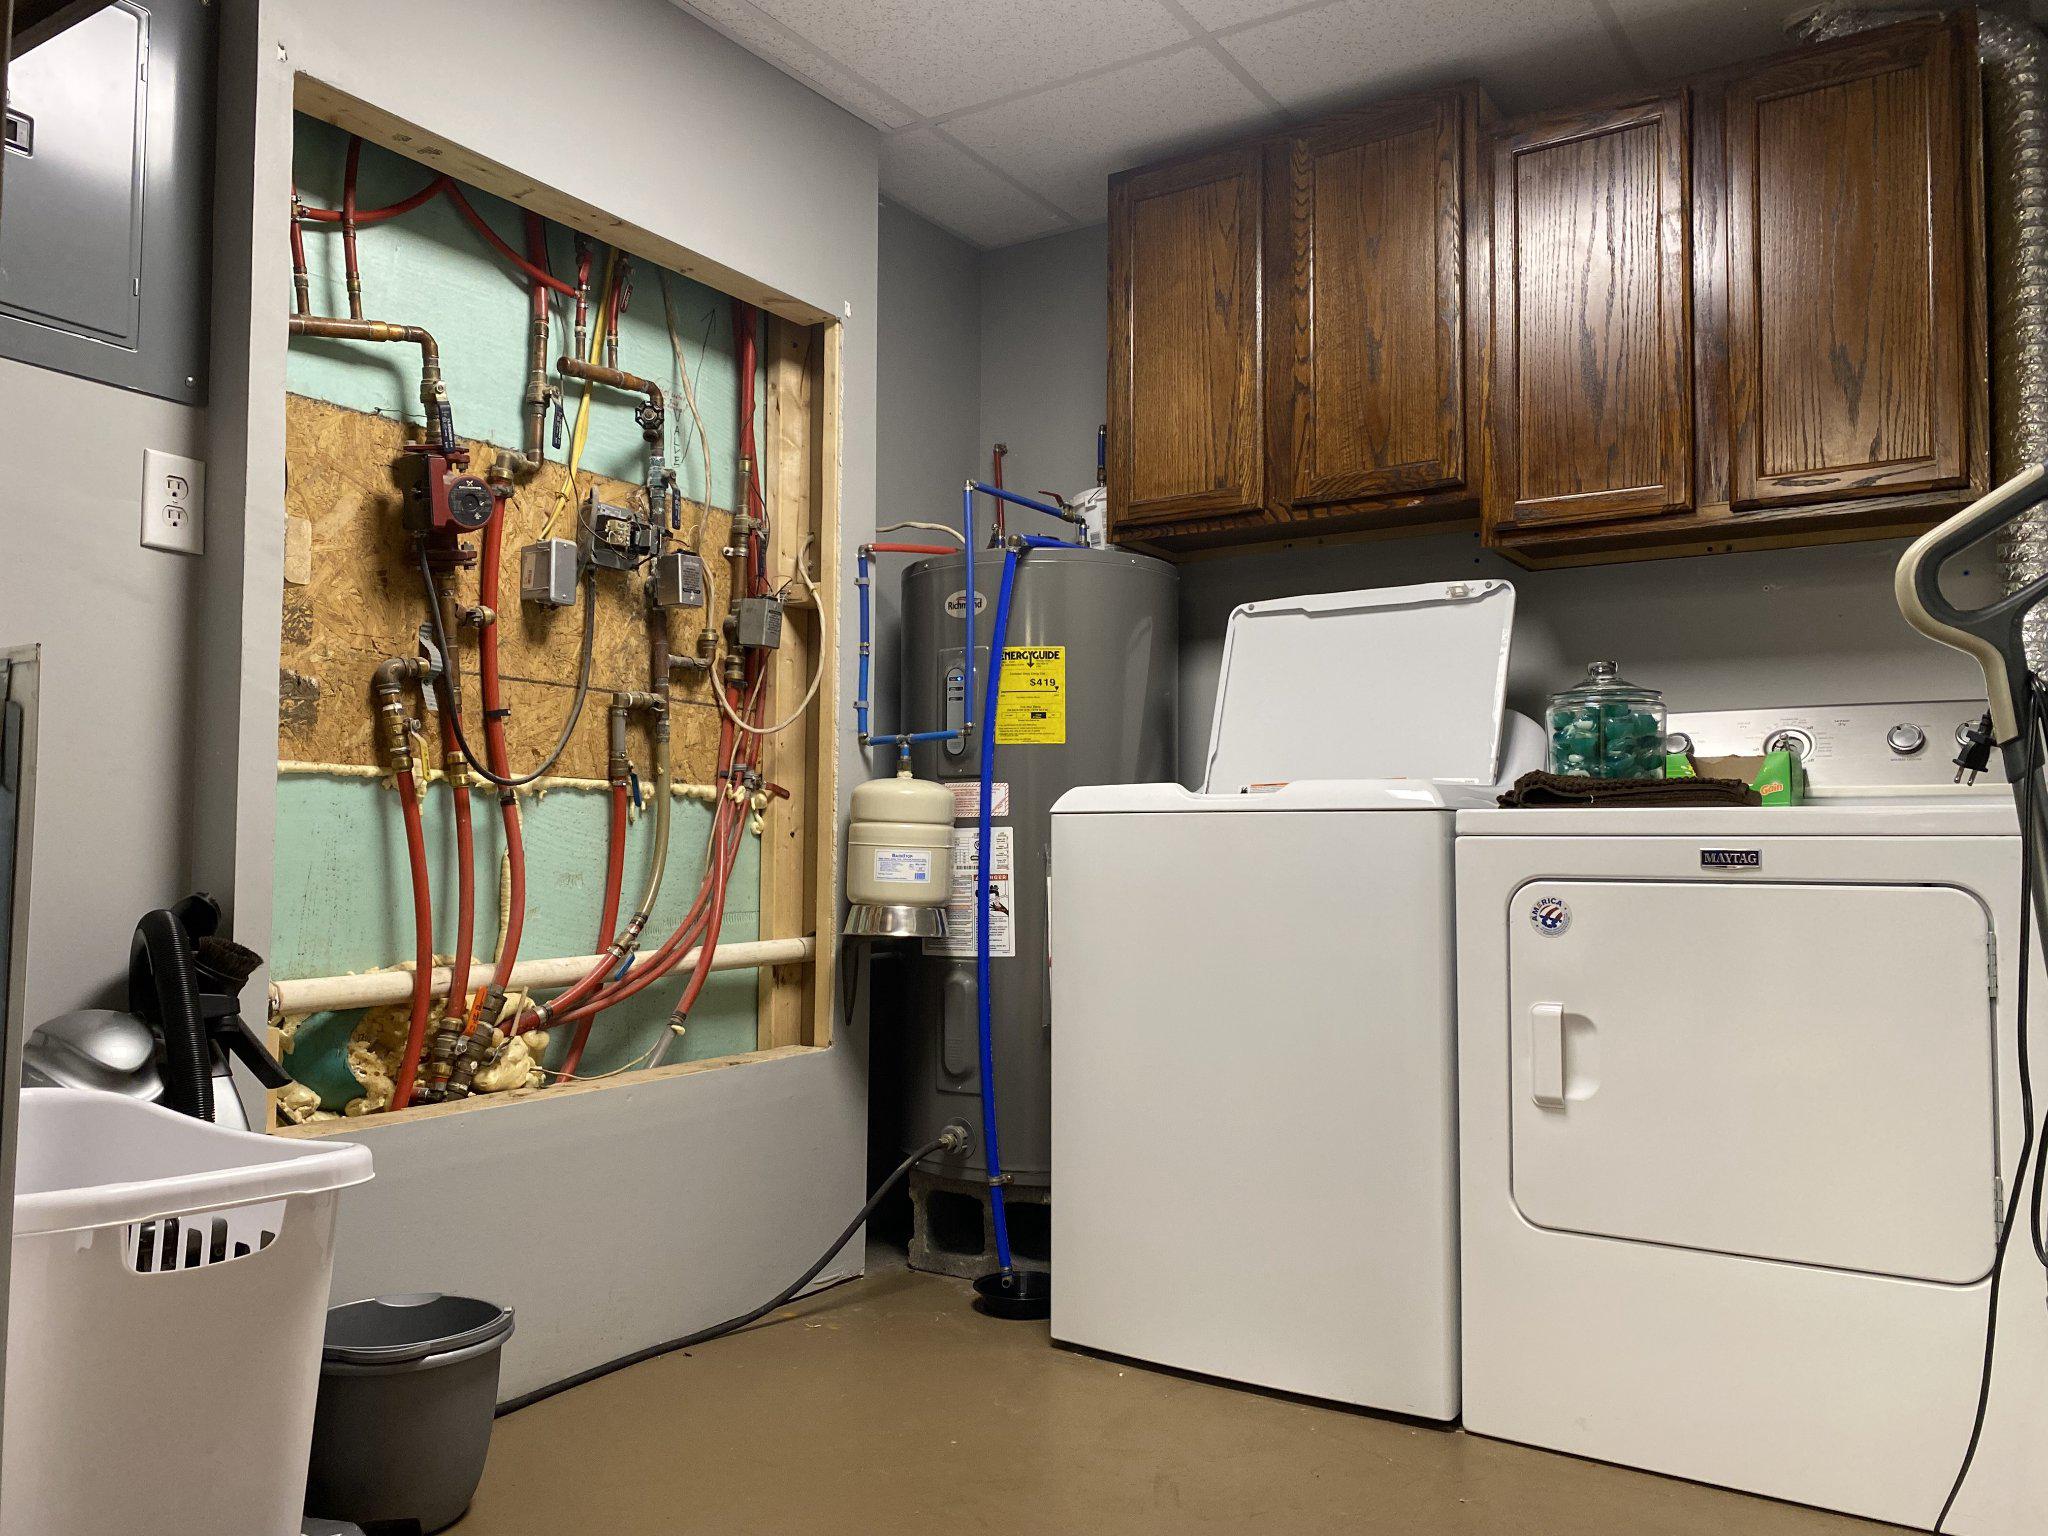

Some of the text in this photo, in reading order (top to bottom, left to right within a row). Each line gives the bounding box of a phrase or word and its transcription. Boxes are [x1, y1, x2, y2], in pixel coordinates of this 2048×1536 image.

[673, 409, 682, 466] VALVE
[948, 599, 982, 610] Richmnd
[1760, 783, 1783, 795] Gain
[1704, 853, 1757, 864] MAYTAG
[1532, 898, 1562, 921] AMERICA
